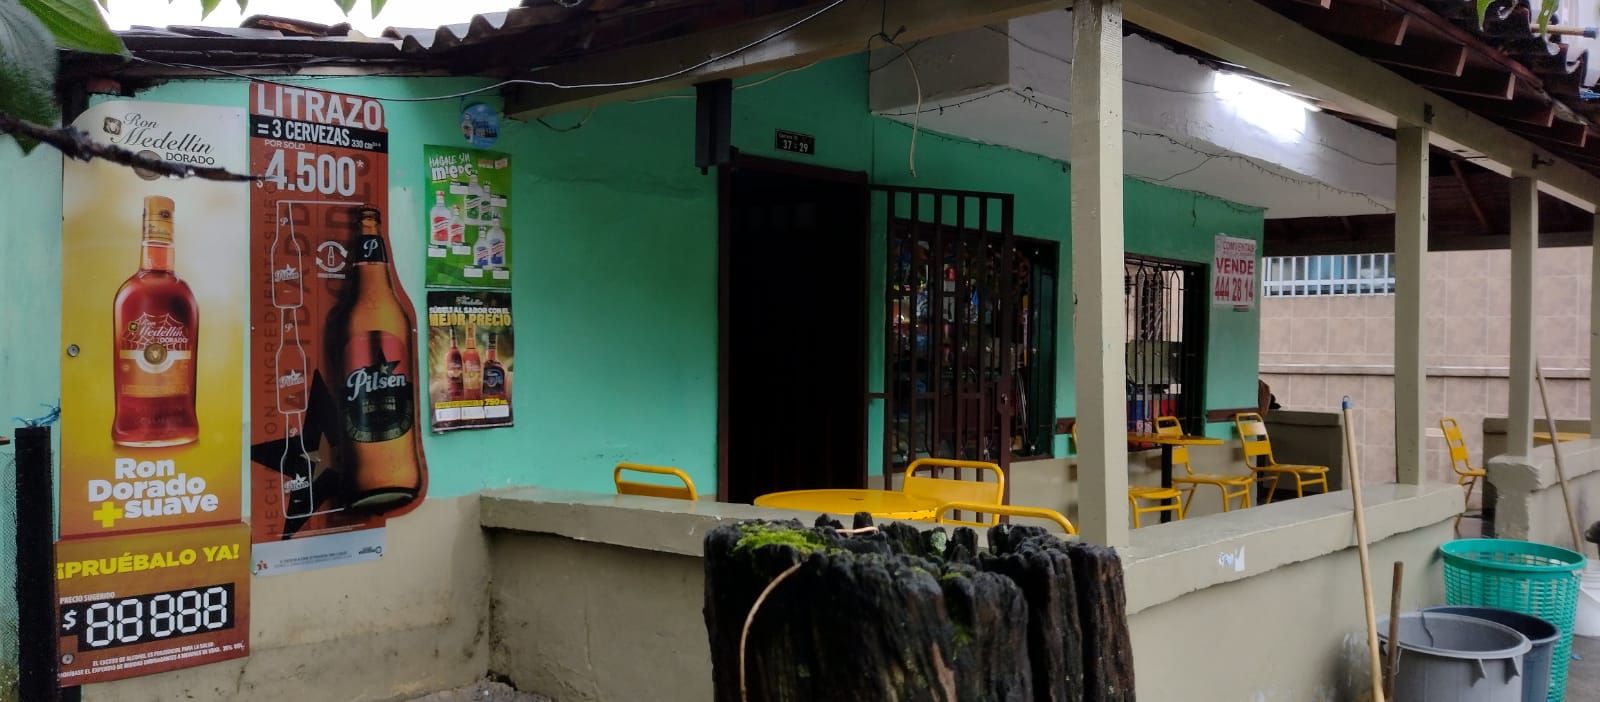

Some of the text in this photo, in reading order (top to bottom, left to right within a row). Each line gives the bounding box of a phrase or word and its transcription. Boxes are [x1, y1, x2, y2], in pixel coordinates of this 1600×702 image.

[257, 82, 382, 131] LITRAZO
[123, 112, 159, 129] Ron
[264, 139, 306, 150] POR SOLO
[272, 119, 282, 138] 3
[285, 120, 350, 147] CERVEZAS
[352, 139, 364, 149] 330
[783, 139, 792, 150] 37
[799, 142, 809, 153] 29
[166, 152, 215, 166] DORADO
[1215, 257, 1254, 275] VENDE
[1231, 277, 1242, 301] 28
[1244, 278, 1254, 302] 14
[429, 313, 512, 327] MEJOR PRECIO
[345, 367, 407, 401] Pilsen
[115, 458, 175, 479] Ron
[88, 473, 206, 502] Dorado
[264, 470, 278, 537] HECH
[57, 543, 240, 580] ¡PRUÉBALO YA!
[60, 595, 83, 604] PRECIO
[62, 609, 77, 630] $
